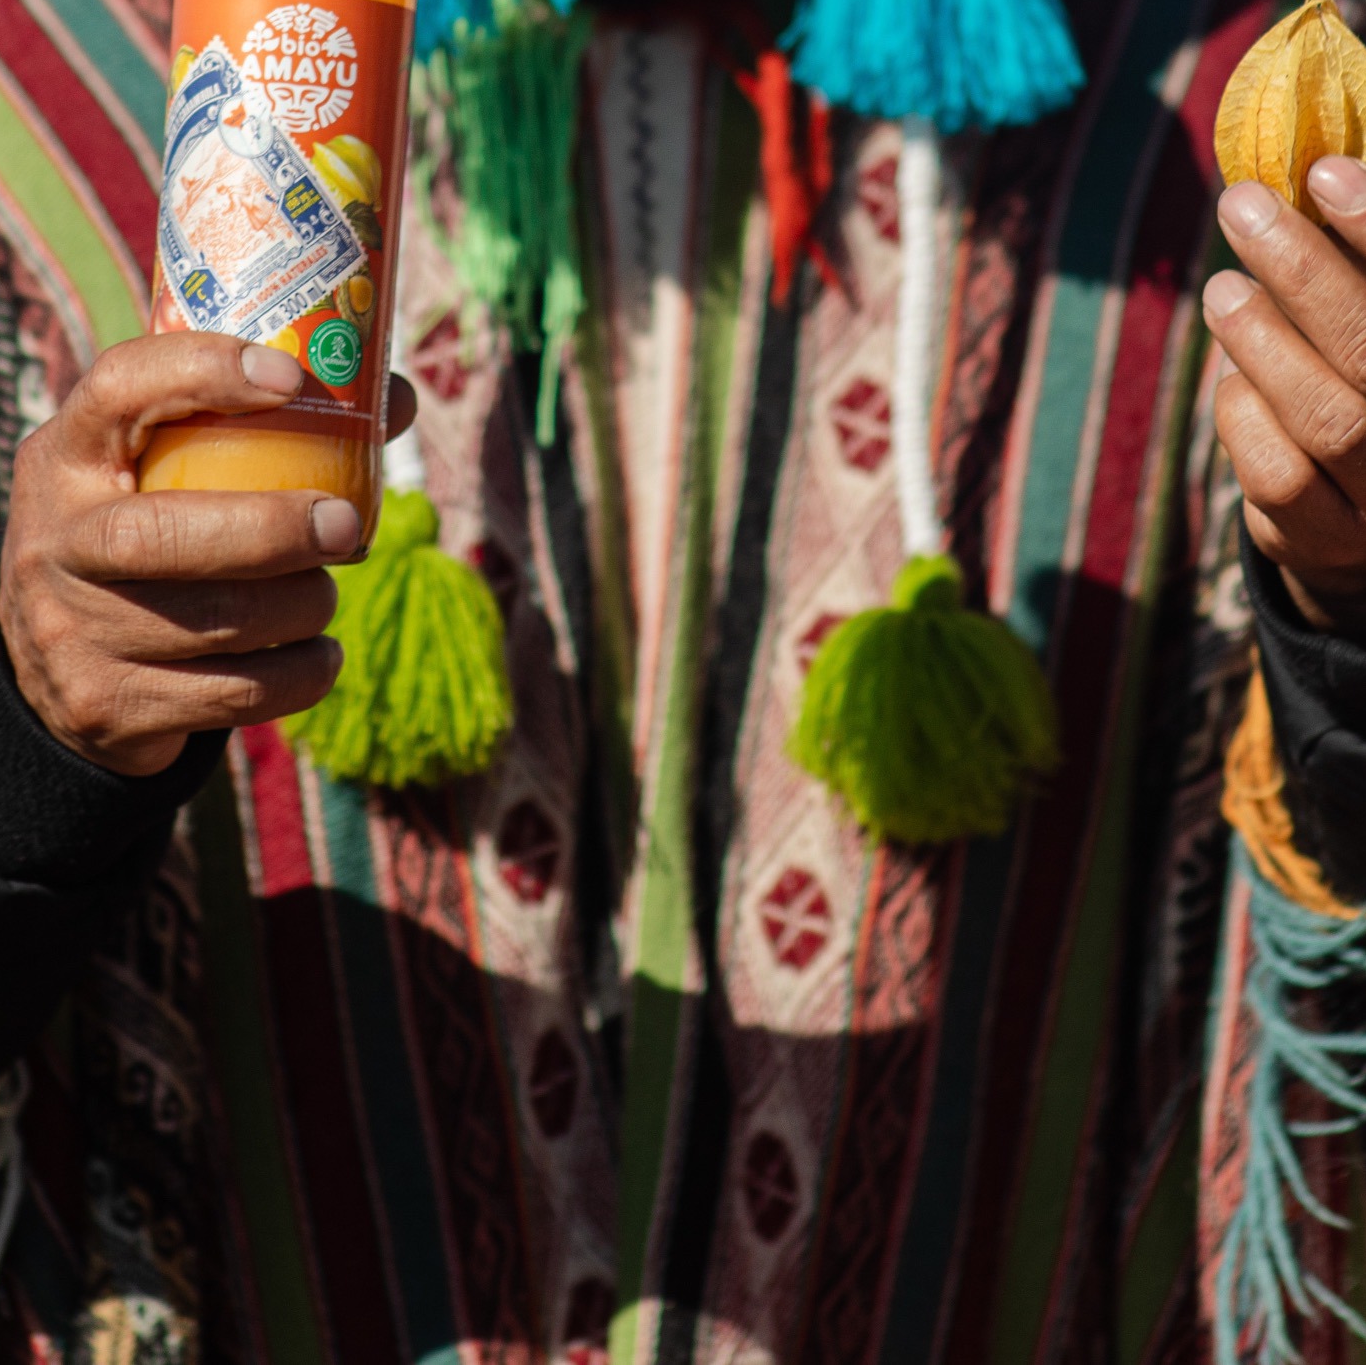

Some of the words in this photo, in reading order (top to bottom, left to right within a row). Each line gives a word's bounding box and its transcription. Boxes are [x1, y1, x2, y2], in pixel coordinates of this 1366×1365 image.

[281, 33, 321, 58] bio
[240, 54, 358, 88] AMAYU
[278, 244, 329, 286] NATURALES
[279, 291, 309, 321] 300
[306, 278, 327, 303] mL
